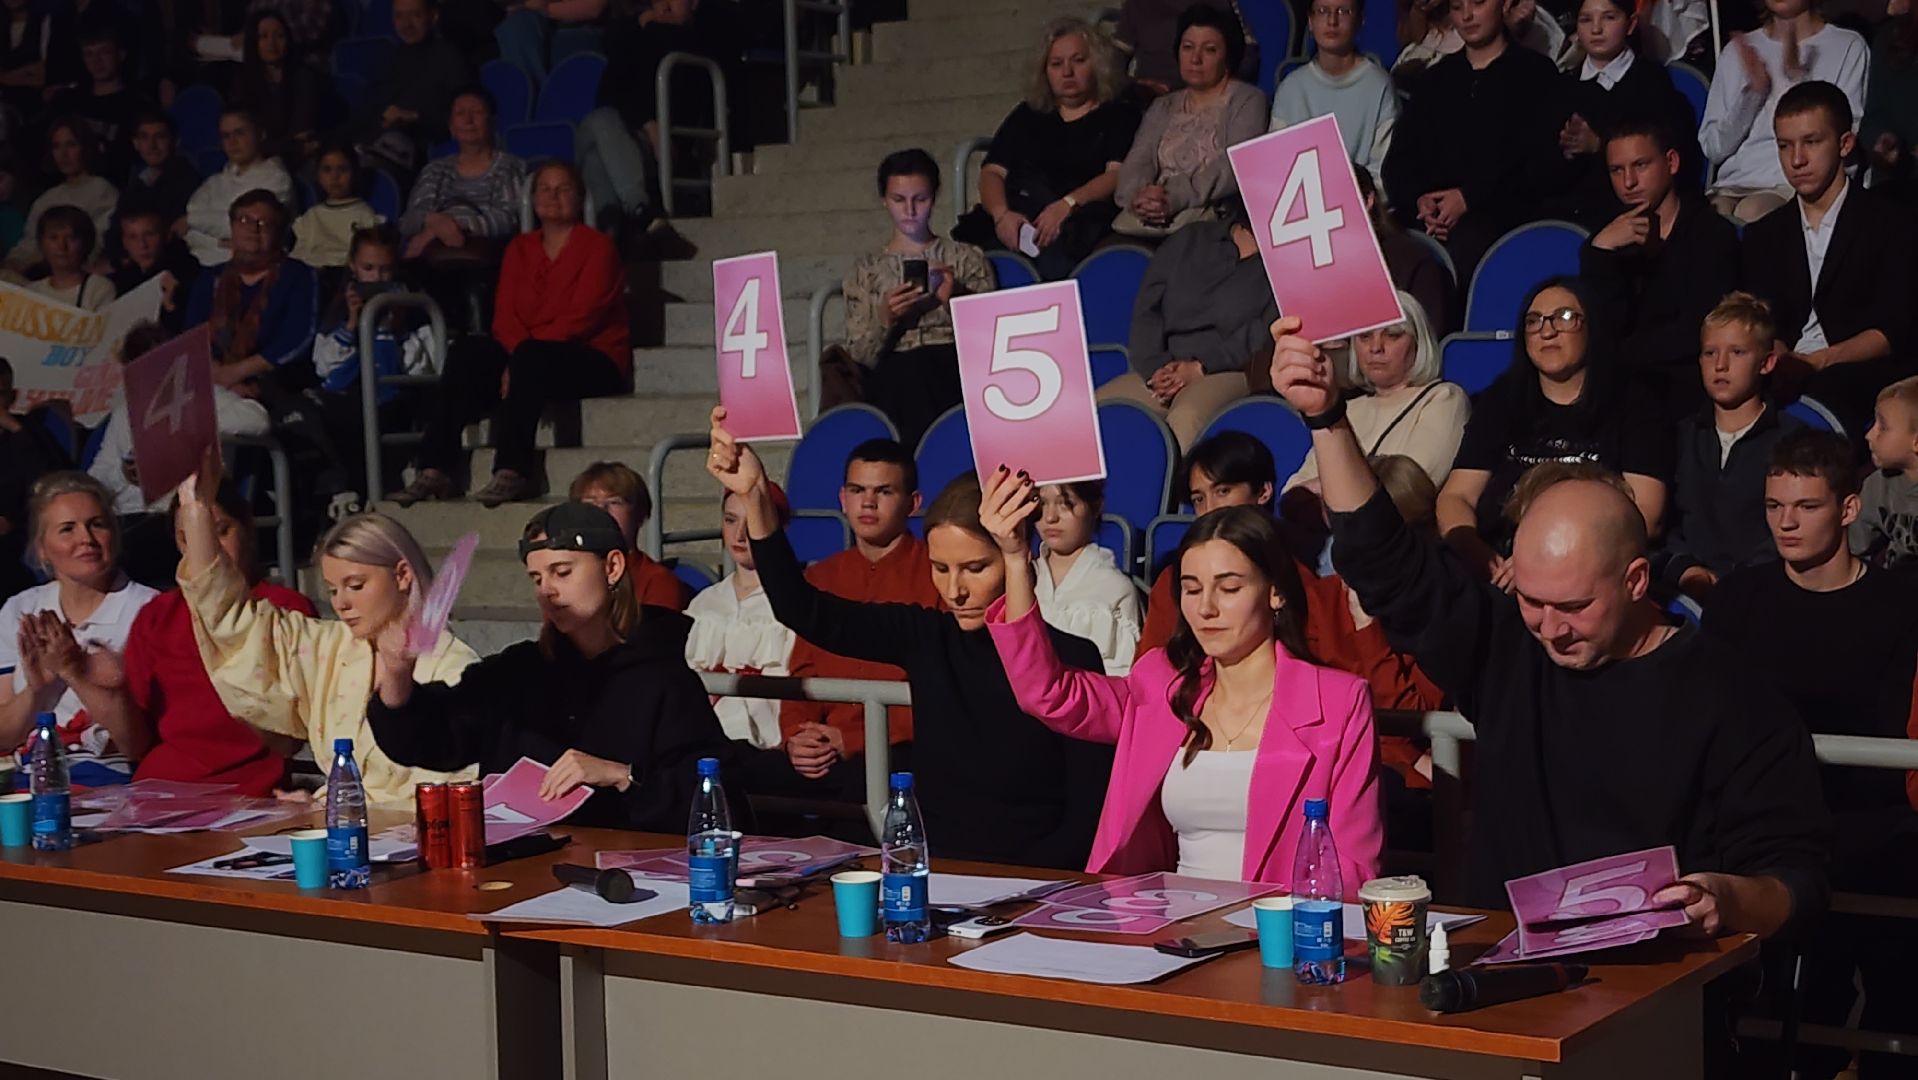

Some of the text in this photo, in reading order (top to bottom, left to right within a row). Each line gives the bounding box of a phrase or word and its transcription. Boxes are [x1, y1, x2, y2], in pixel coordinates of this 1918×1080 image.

[1269, 145, 1346, 270] 4
[721, 277, 769, 379] 4
[982, 304, 1064, 421] 5
[143, 353, 195, 434] 4
[1547, 860, 1649, 920] 5
